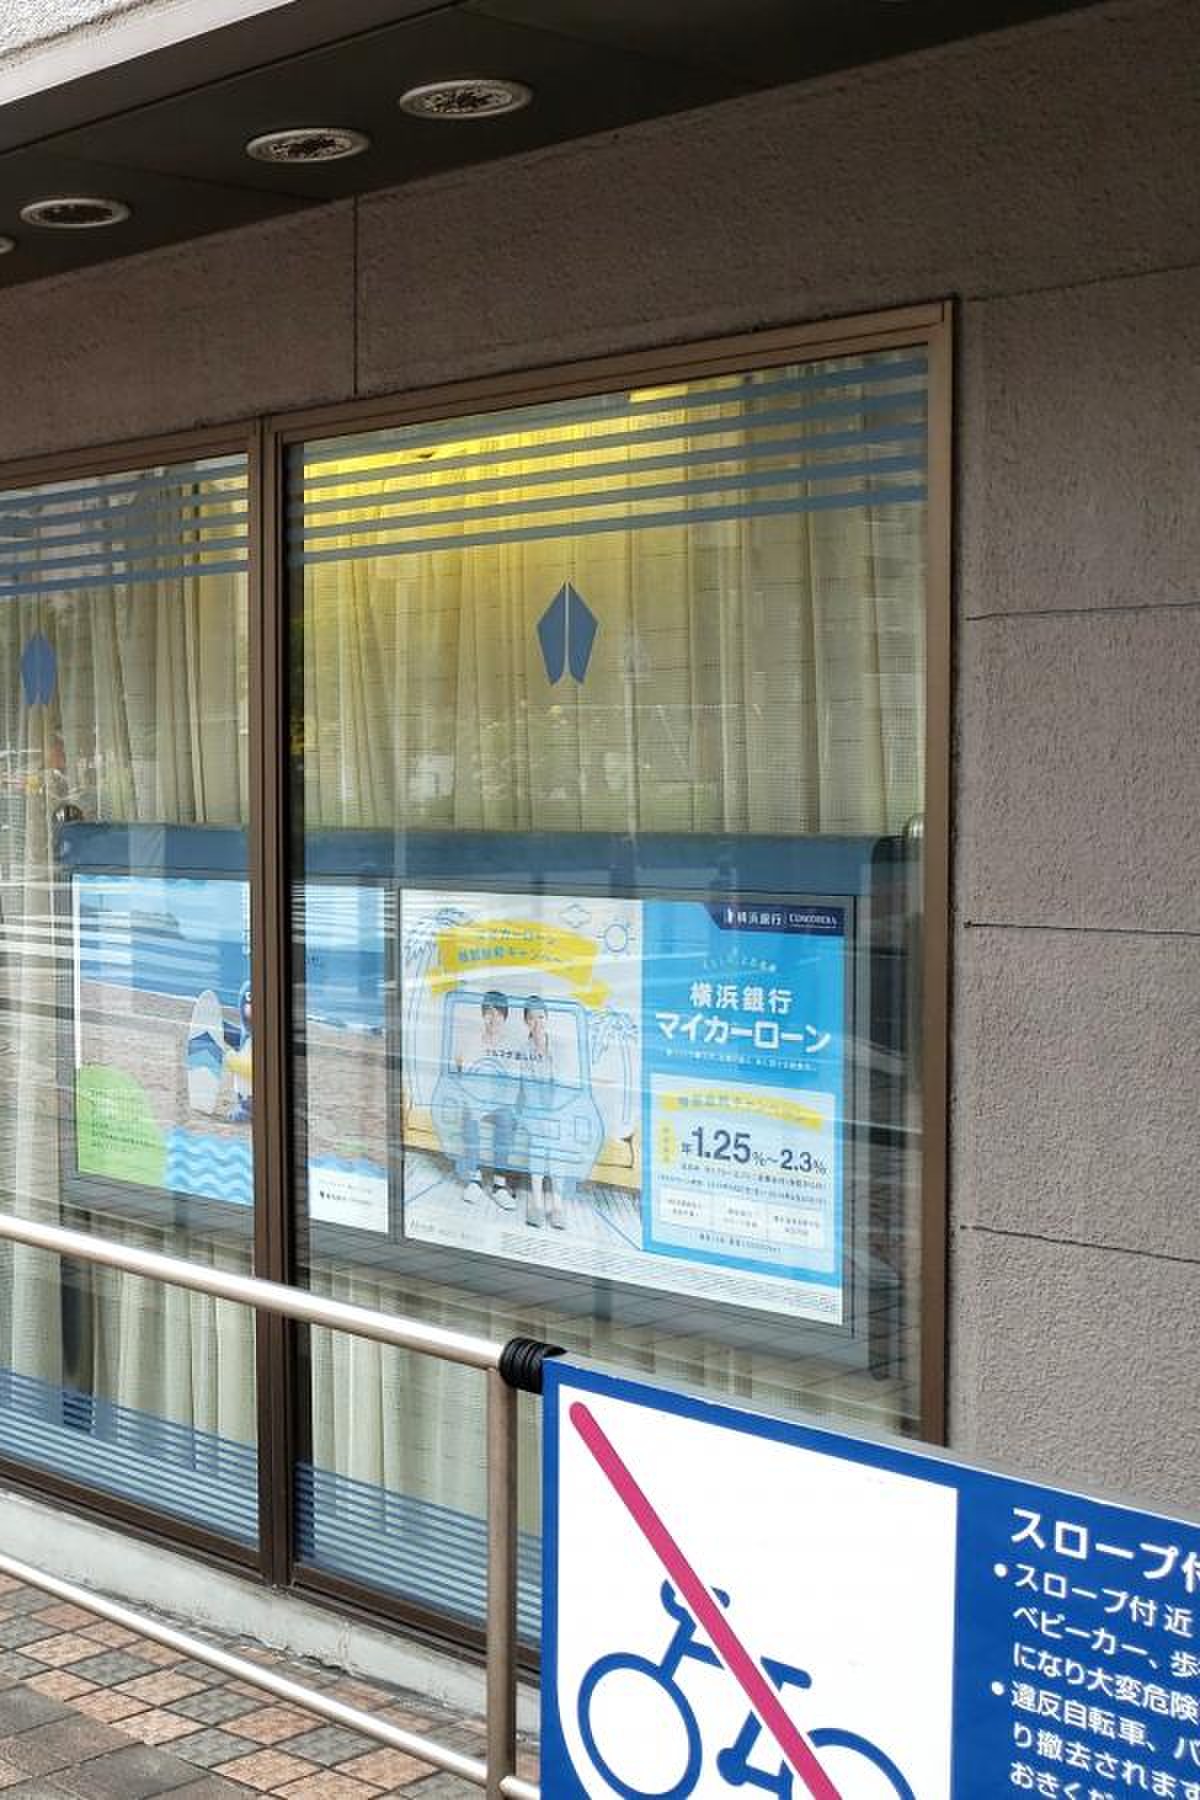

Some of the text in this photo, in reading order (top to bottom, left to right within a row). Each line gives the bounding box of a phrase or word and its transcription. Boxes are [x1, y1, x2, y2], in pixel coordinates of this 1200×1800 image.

[689, 981, 793, 1015] 横浜銀行
[655, 1012, 831, 1053] マイカーローン
[1013, 1642, 1200, 1726] になり大変危険
